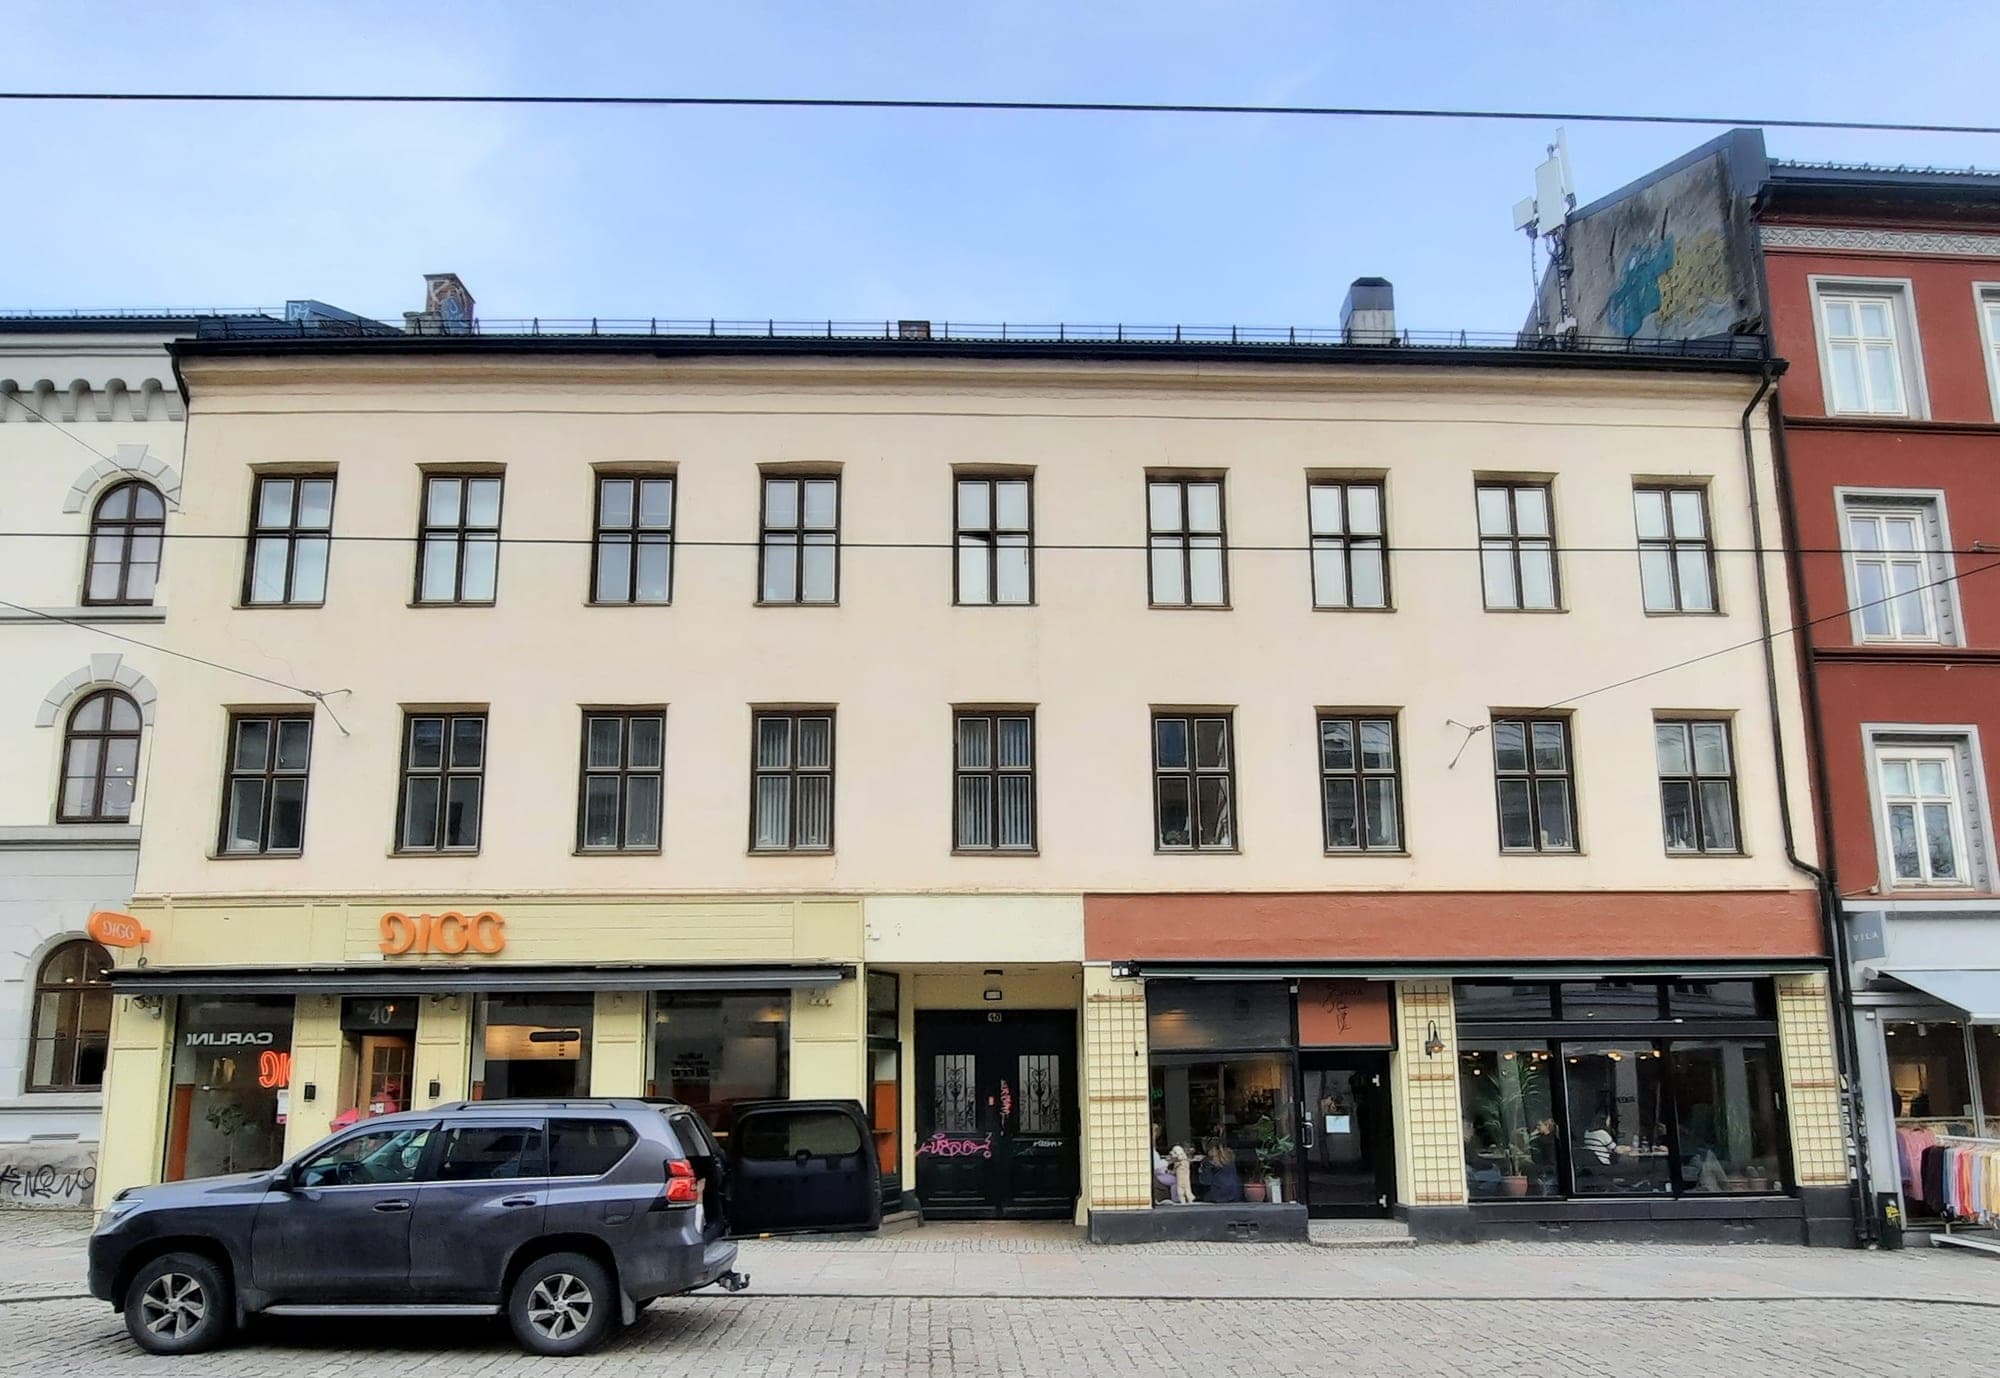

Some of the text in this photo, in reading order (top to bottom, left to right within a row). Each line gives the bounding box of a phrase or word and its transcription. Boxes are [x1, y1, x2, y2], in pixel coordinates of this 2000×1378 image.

[102, 920, 135, 940] DIGG
[378, 912, 505, 955] DIGG
[1852, 930, 1879, 942] VILA
[368, 1005, 392, 1025] 40
[259, 1050, 293, 1088] DI
